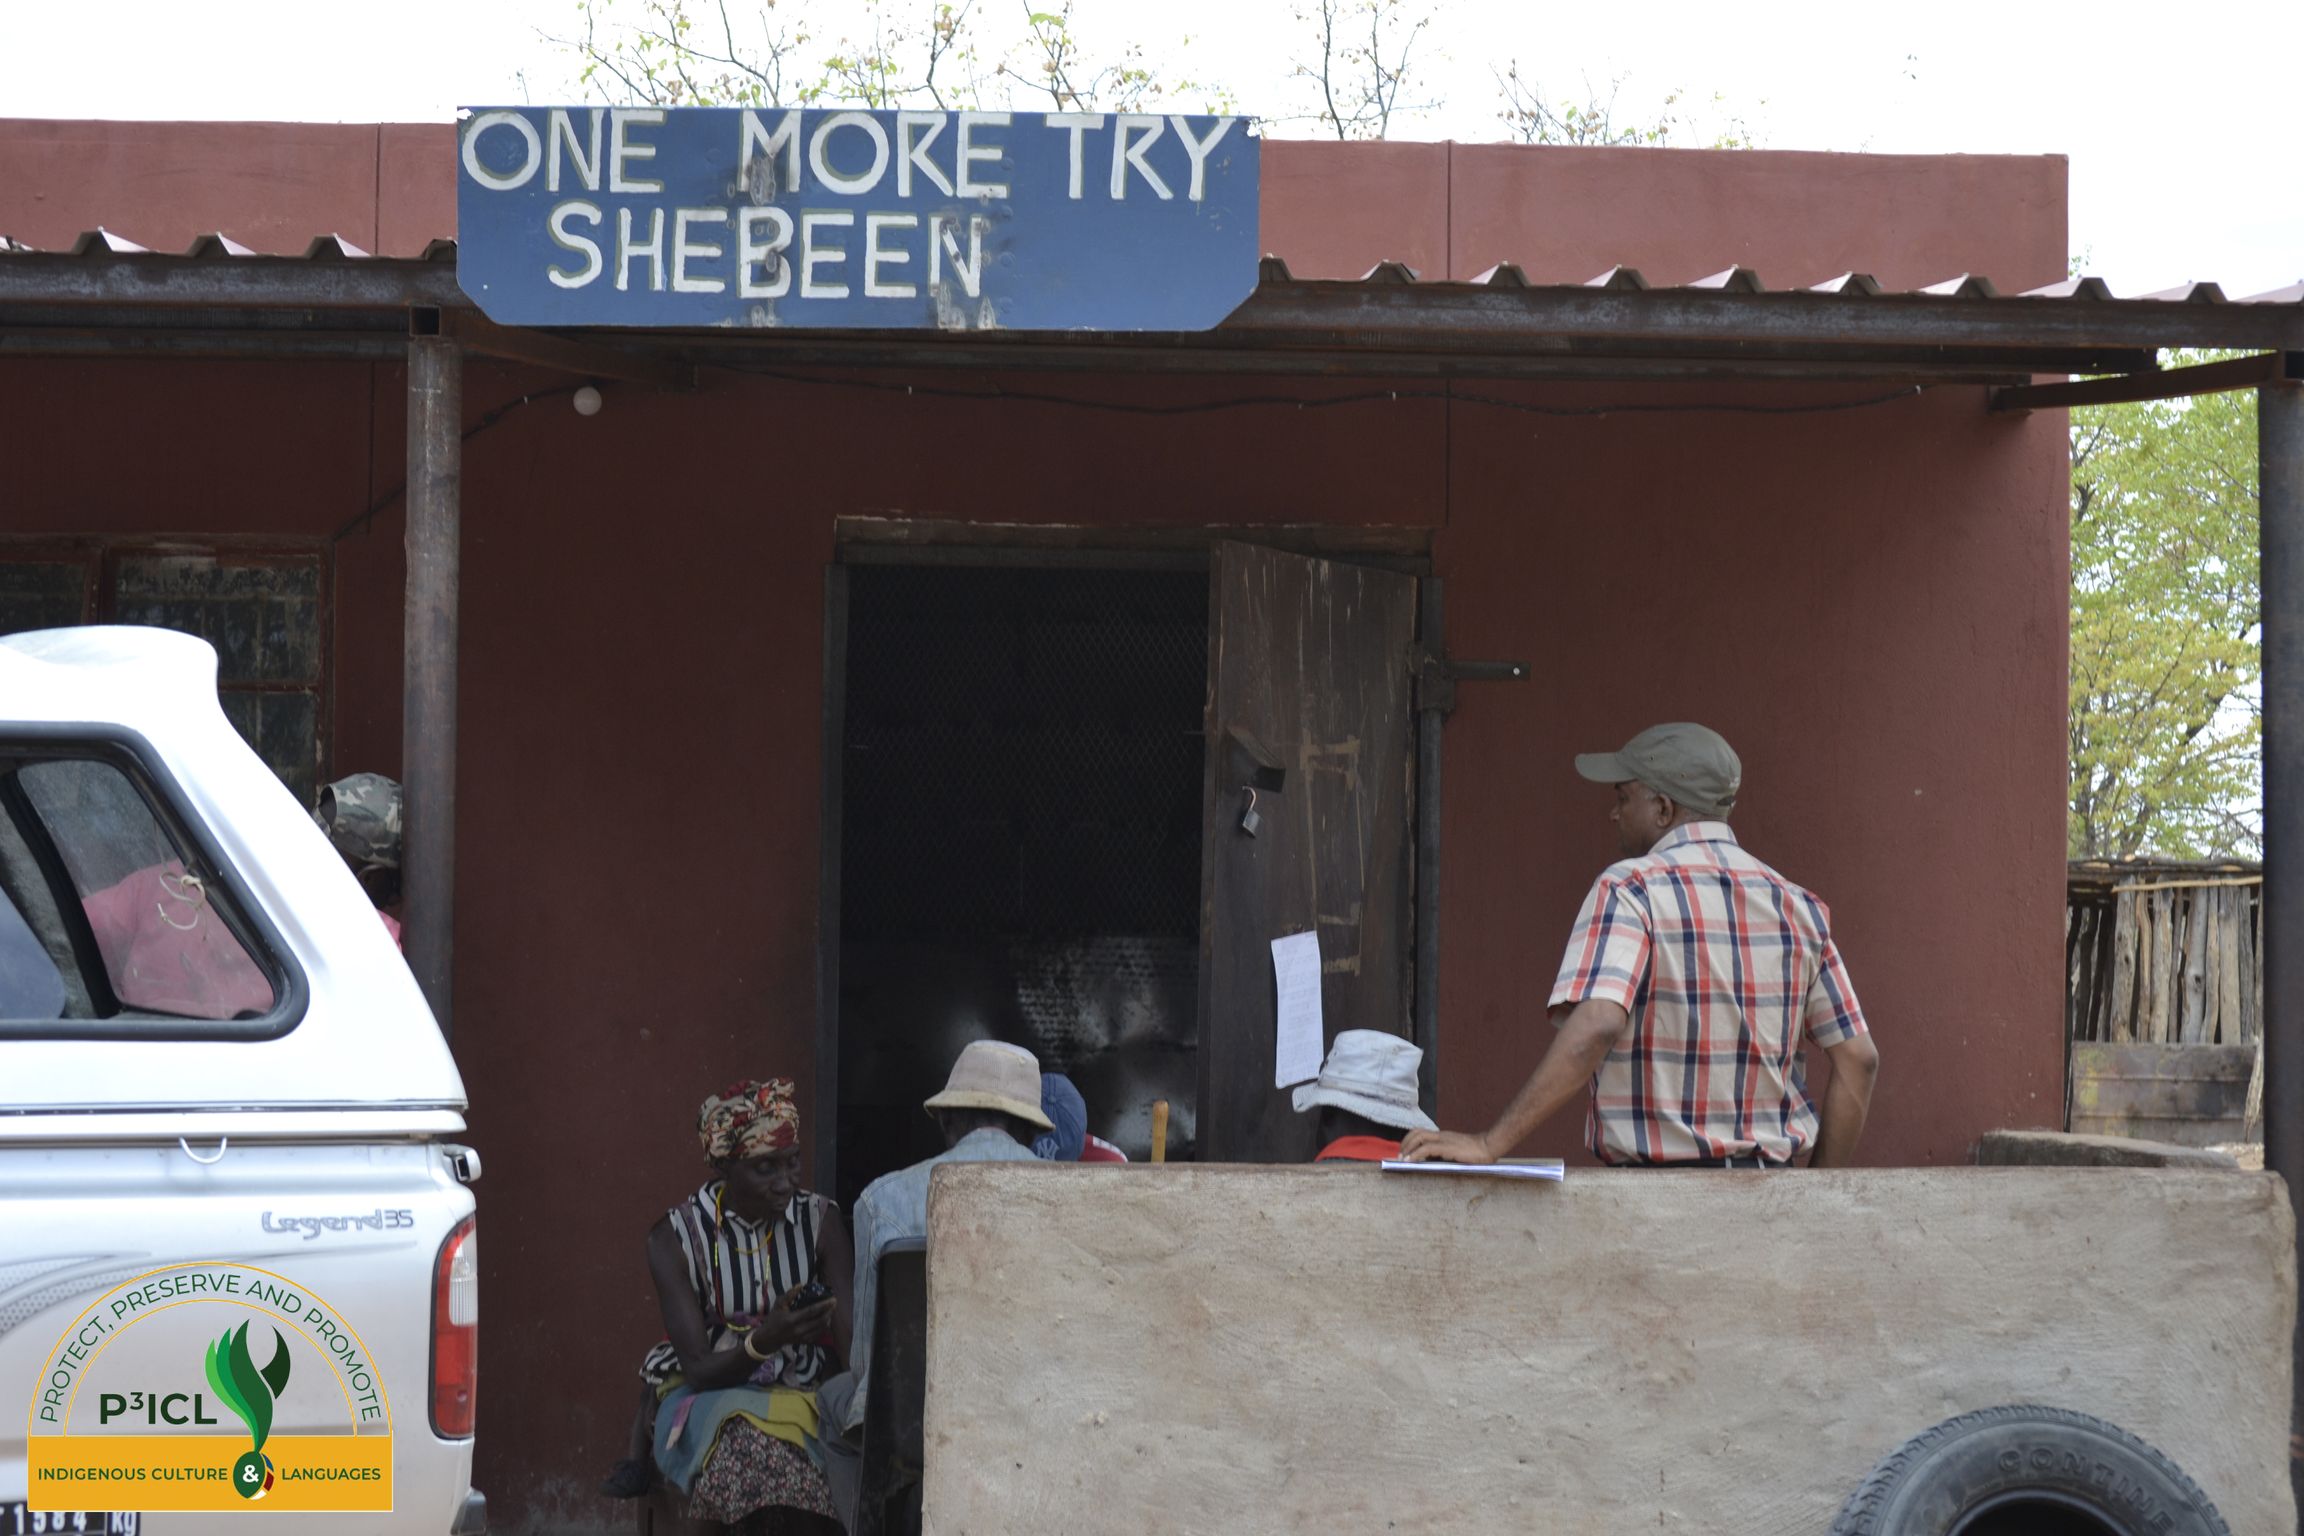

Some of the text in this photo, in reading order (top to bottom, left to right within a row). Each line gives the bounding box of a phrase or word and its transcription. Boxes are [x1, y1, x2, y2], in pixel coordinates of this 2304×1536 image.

[460, 108, 1237, 201] ONE MORE TRY
[546, 199, 983, 300] SHEBEEN
